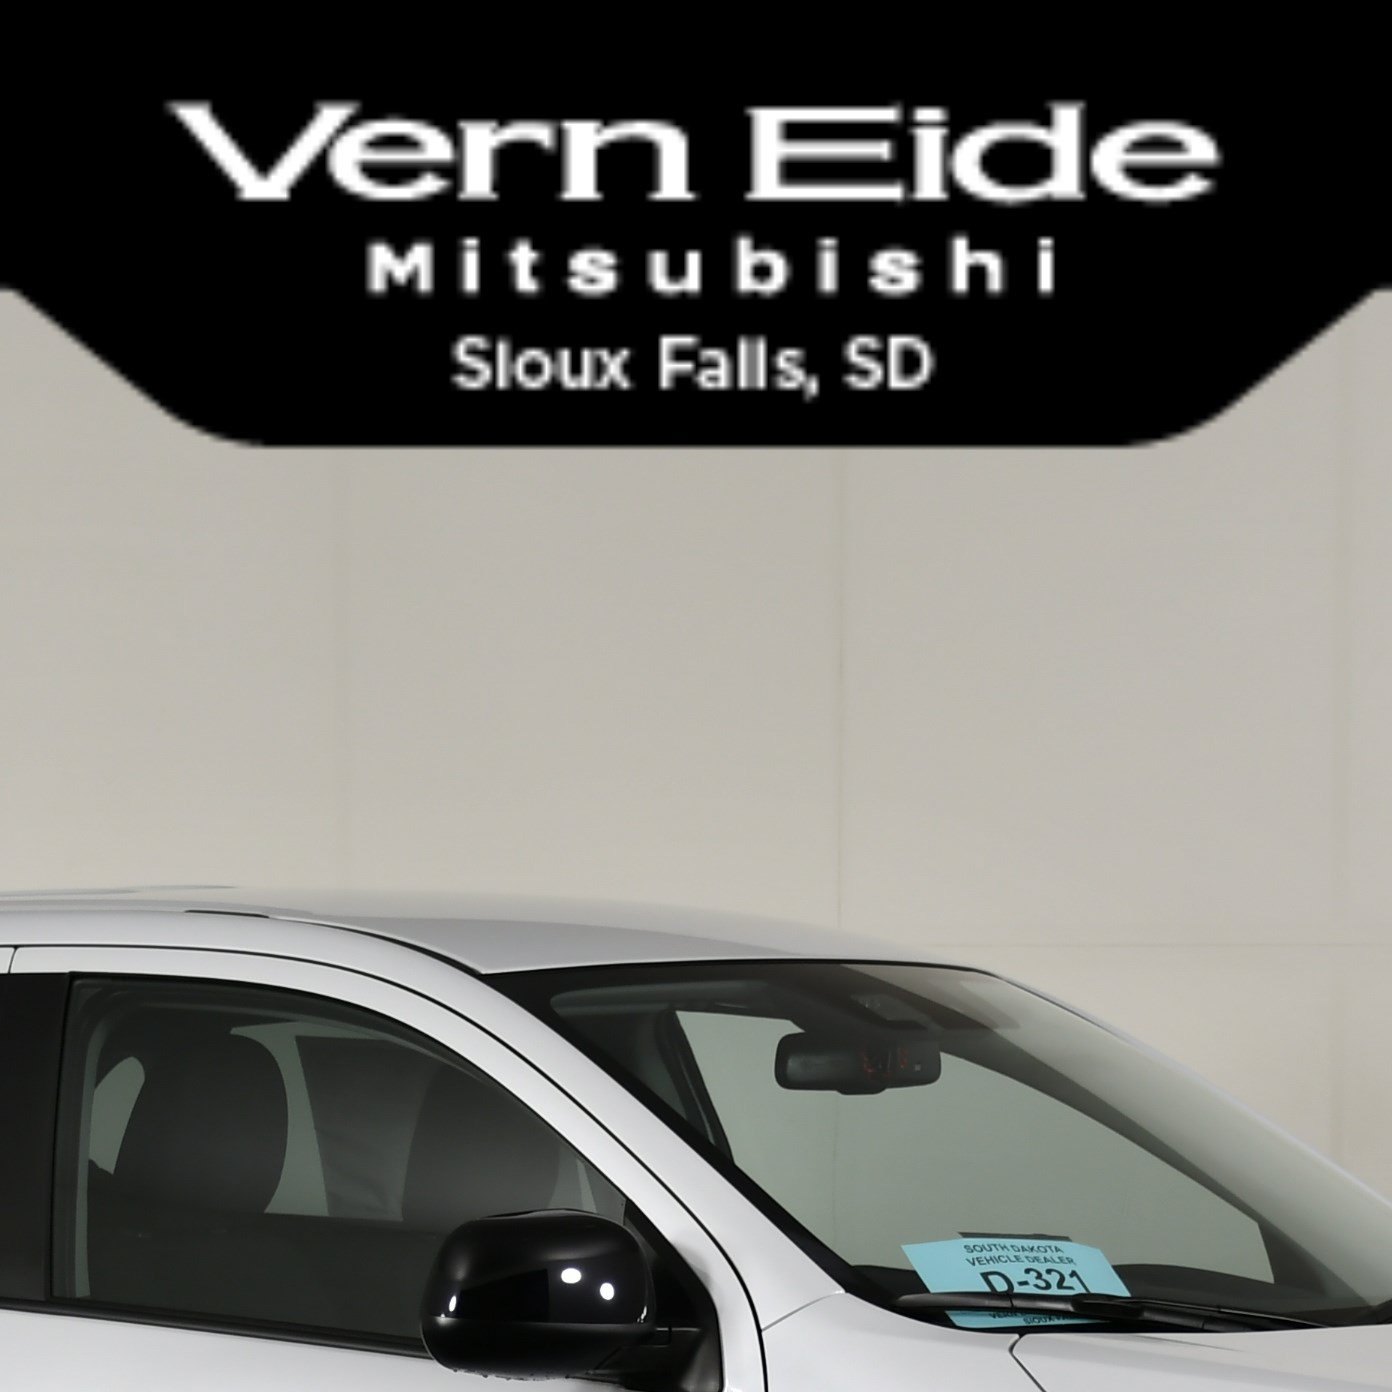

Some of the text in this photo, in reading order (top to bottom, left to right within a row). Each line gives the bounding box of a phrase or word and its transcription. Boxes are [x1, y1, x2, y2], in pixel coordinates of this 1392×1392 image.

[963, 1243, 1064, 1254] SOUTH DAKOTA
[965, 1254, 1077, 1267] VEHICLE DEALER
[979, 1267, 1091, 1295] D-321
